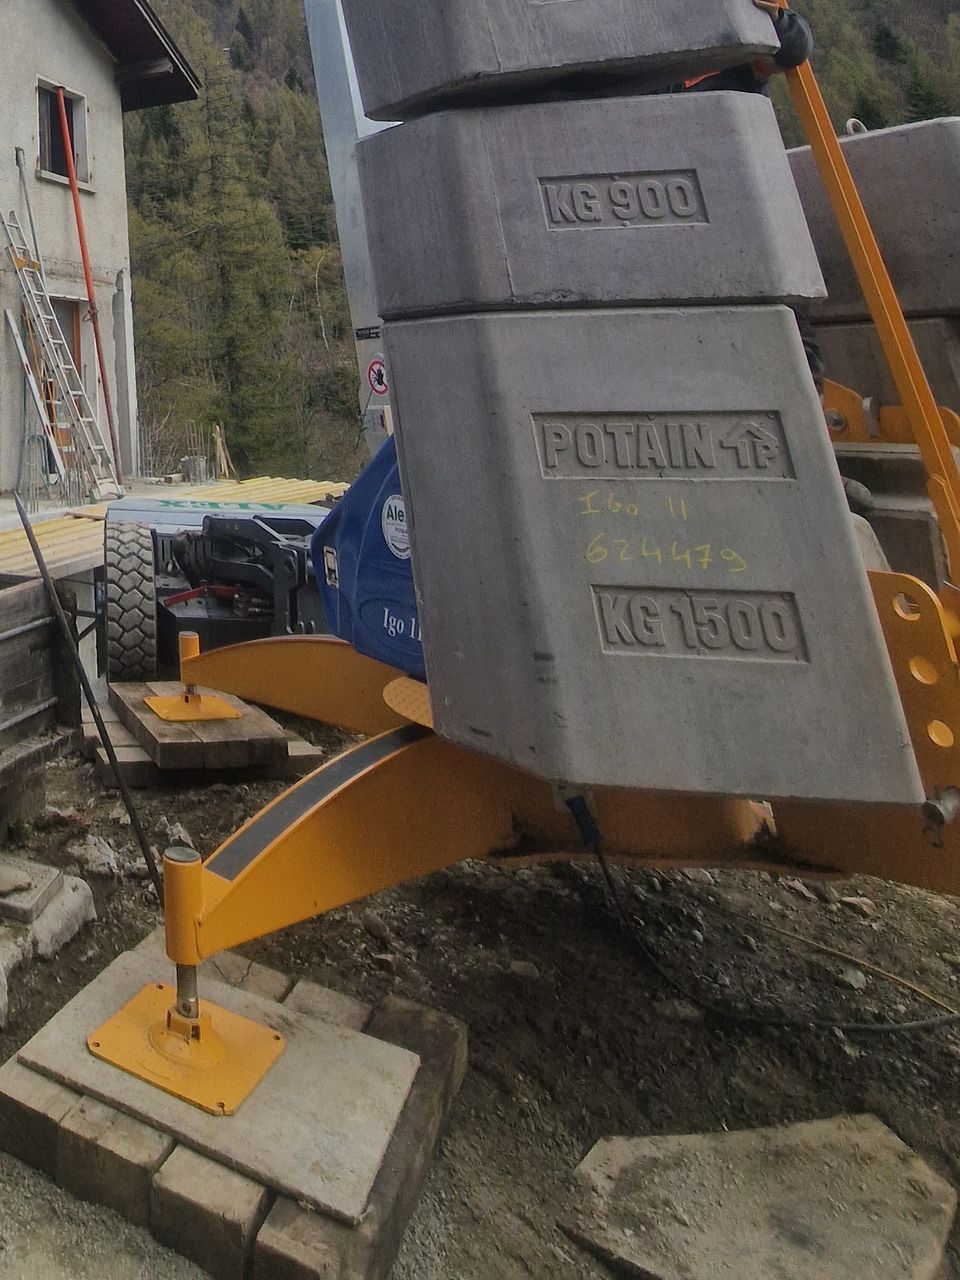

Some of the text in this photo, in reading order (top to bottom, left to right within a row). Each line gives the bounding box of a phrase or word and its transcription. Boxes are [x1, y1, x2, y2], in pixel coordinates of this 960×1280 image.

[545, 178, 697, 224] KG 900
[542, 423, 717, 469] POTAIN
[386, 504, 406, 523] Ale
[585, 532, 747, 572] 624479
[383, 607, 405, 637] Igo
[599, 593, 796, 653] KG 1500
